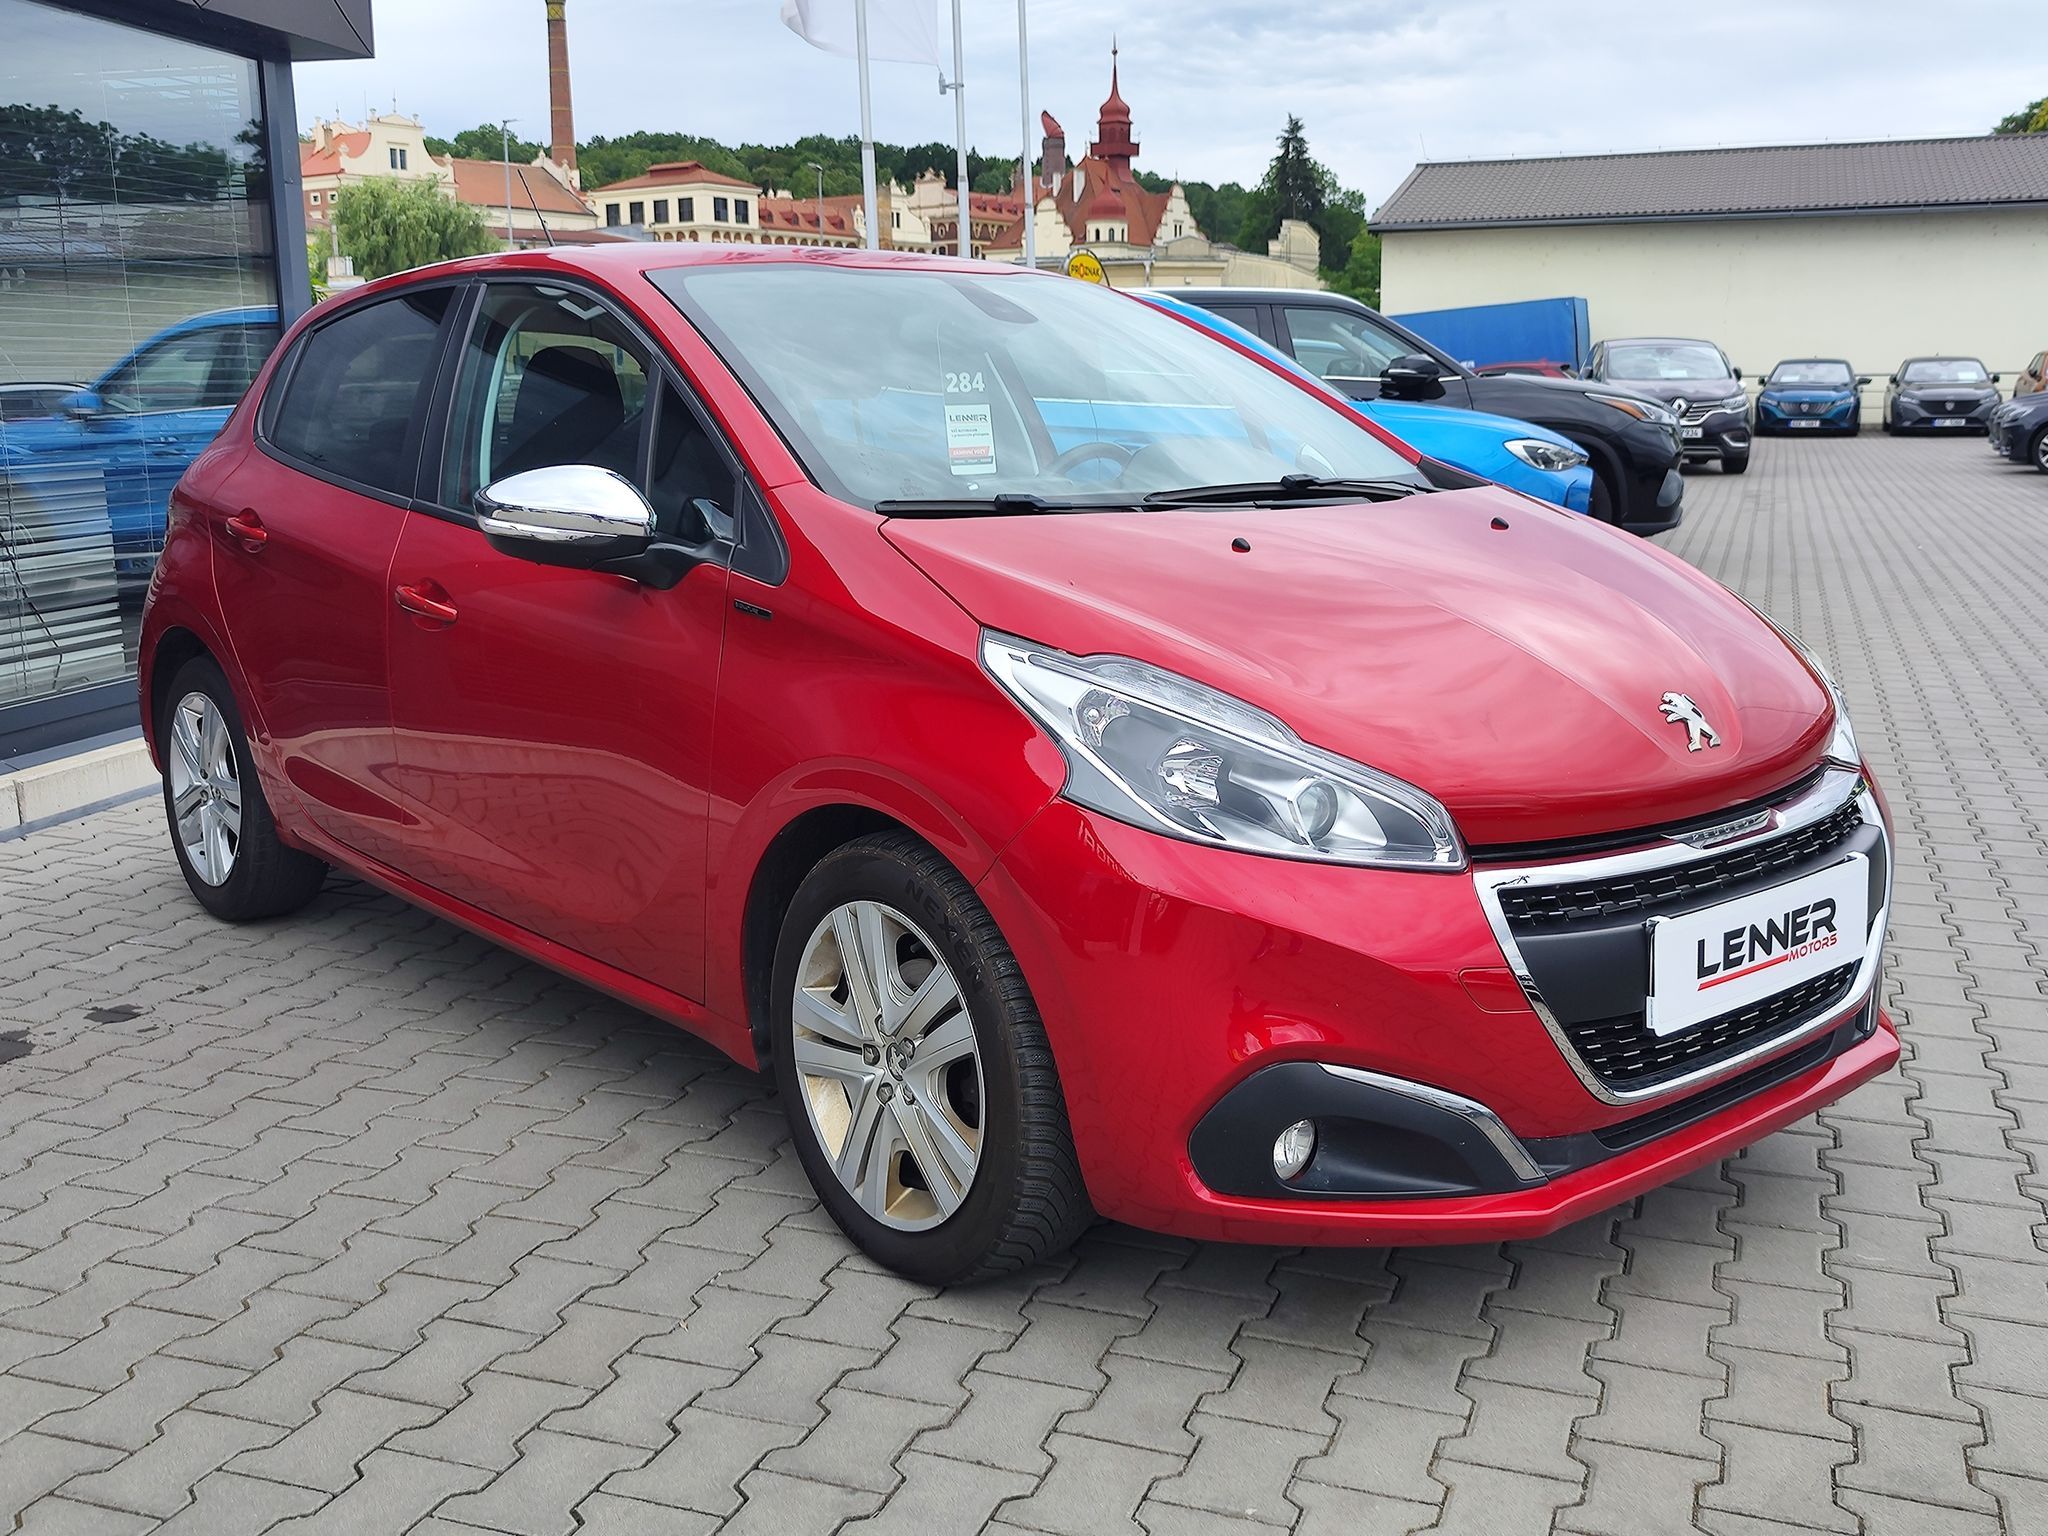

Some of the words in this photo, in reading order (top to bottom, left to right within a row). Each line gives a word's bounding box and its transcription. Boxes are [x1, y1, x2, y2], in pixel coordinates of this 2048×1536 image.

[945, 372, 985, 393] 284
[949, 414, 988, 422] LENNER
[1691, 818, 1757, 841] PEUGEOT
[1697, 897, 1838, 980] LENNER
[1788, 933, 1838, 962] MOTORS
